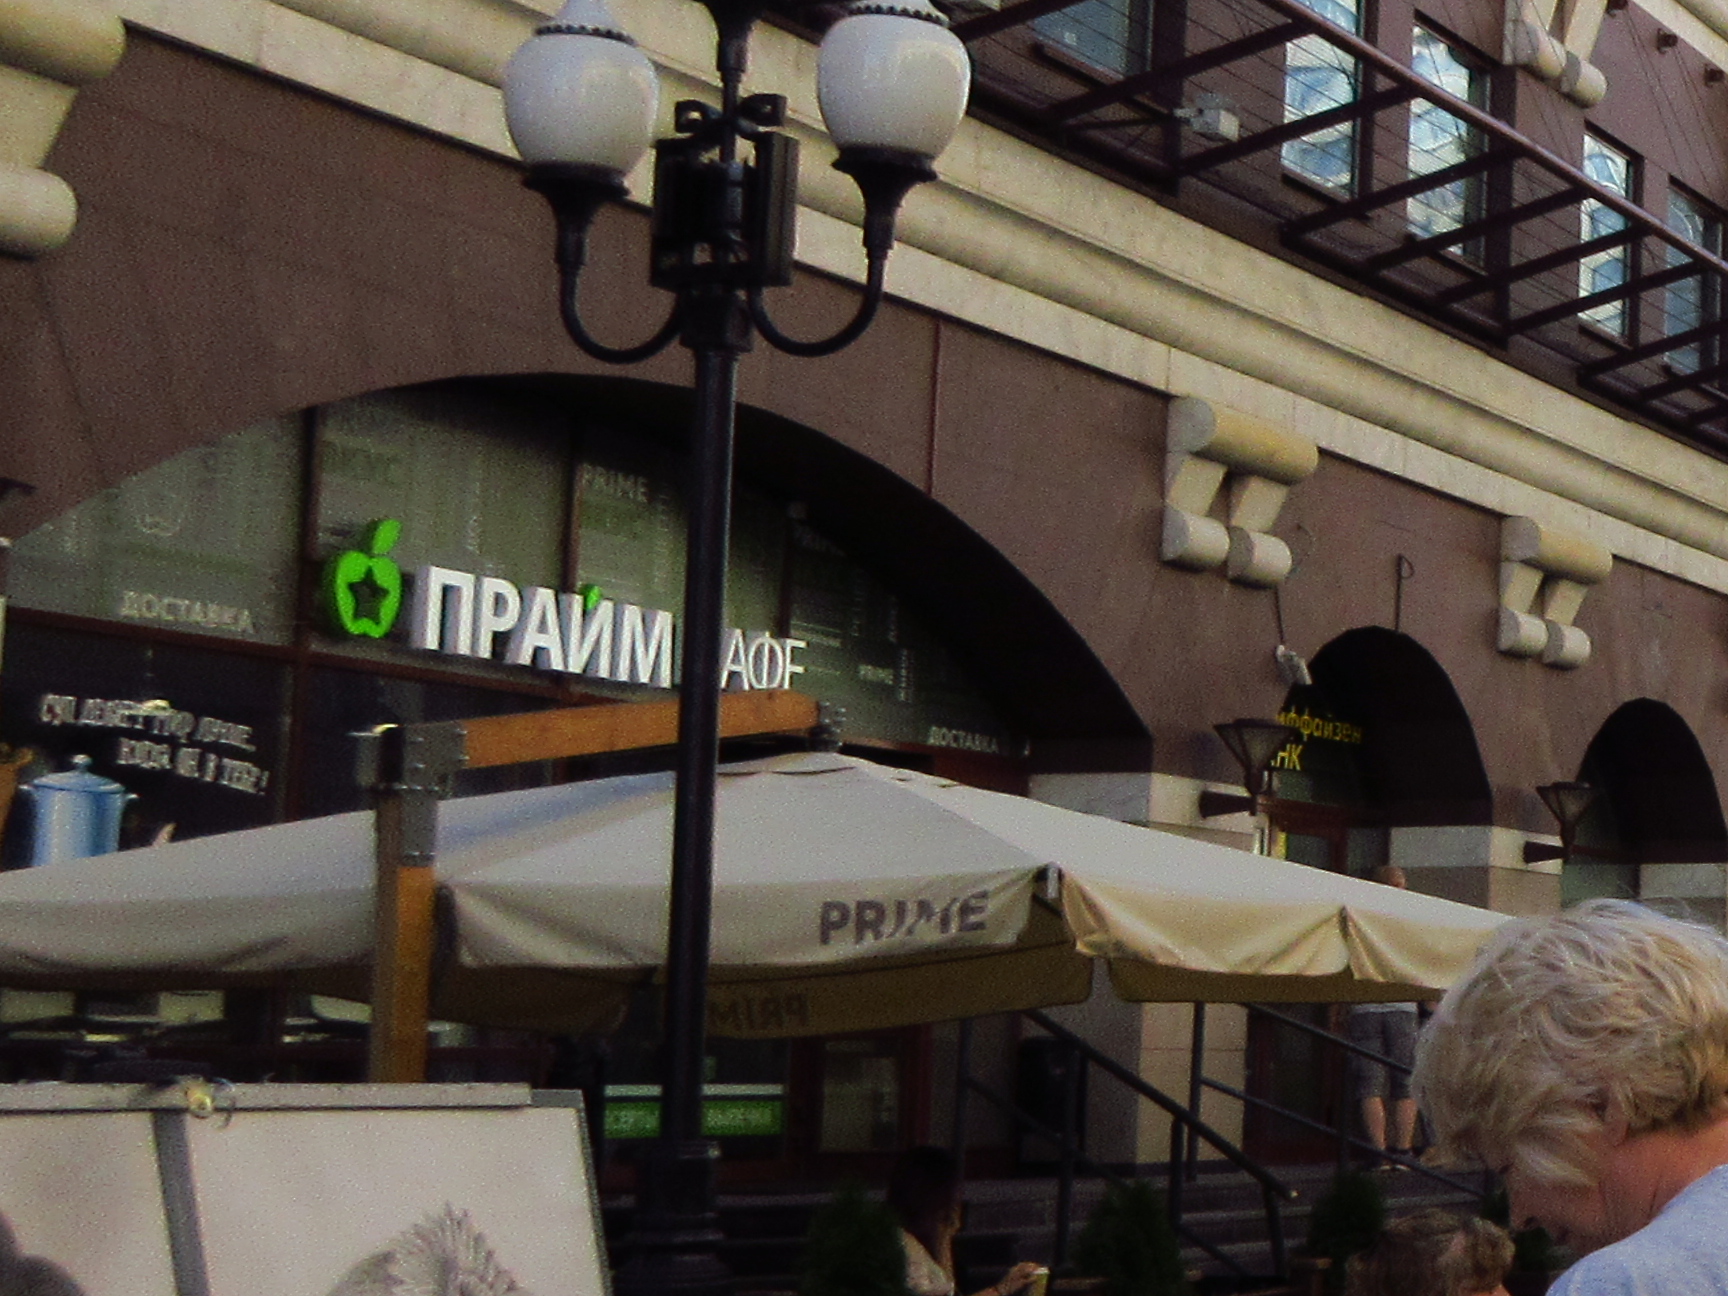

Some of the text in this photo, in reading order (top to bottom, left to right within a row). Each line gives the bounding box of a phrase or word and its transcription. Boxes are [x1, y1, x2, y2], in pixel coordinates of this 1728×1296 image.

[412, 564, 675, 689] ПРАЙМ
[718, 627, 808, 692] АФЕ
[1270, 742, 1304, 772] НК
[820, 889, 990, 946] PRIME
